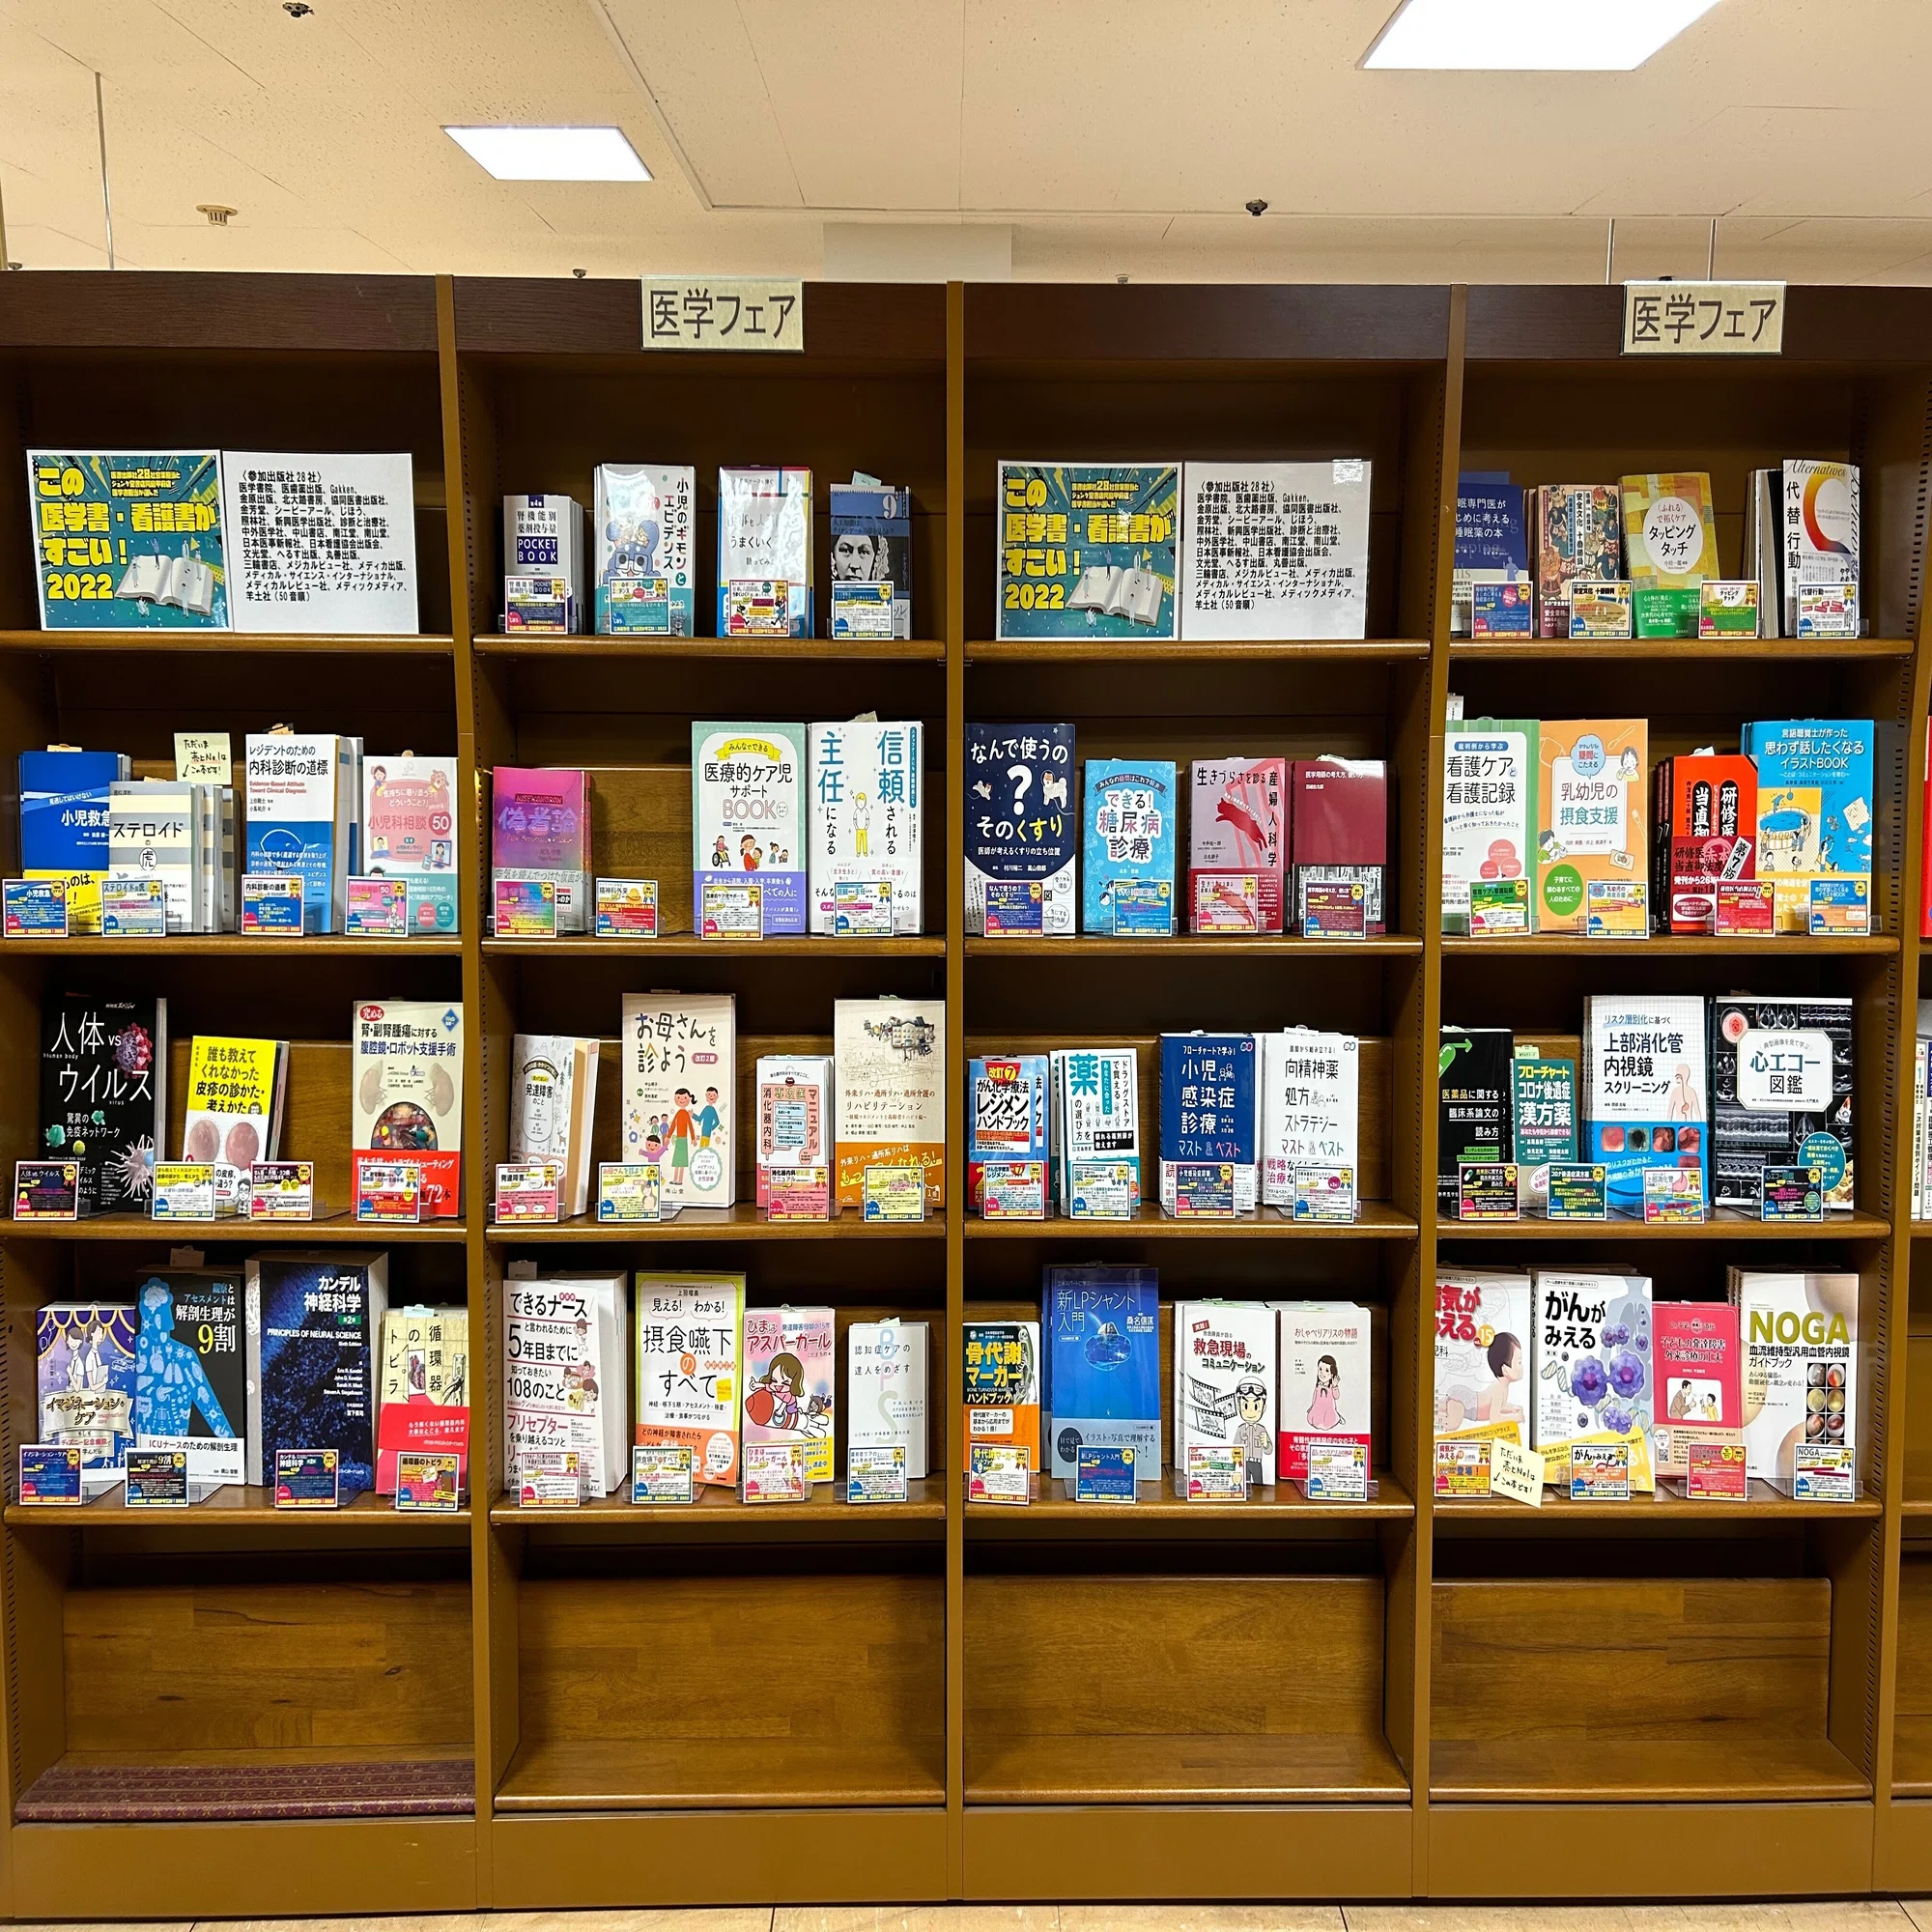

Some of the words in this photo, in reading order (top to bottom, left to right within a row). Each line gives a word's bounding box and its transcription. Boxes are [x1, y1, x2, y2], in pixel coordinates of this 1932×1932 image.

[650, 288, 796, 338] 医学フェア
[1633, 294, 1776, 344] 医学フェア
[39, 468, 84, 496] この
[1007, 478, 1047, 507] この
[40, 499, 218, 532] 医学書・看護書が
[517, 510, 557, 522] 腎機能別
[517, 524, 557, 533] 薬剤投与量
[676, 477, 689, 586] 小児のギモンと
[1006, 509, 1176, 543] 医学書・看護書が
[1649, 524, 1696, 540] タッピング
[1786, 481, 1801, 570] 代替行動
[43, 538, 128, 566] すごい！
[518, 539, 557, 550] POCKET
[1661, 541, 1688, 556] タッチ
[518, 551, 557, 561] BOOK
[1006, 549, 1080, 577] すごい！
[47, 574, 113, 600] 2022
[1005, 582, 1065, 610] 2022
[1782, 728, 1848, 738] 言語聴覚士が作った
[184, 739, 209, 750] ただいま
[249, 745, 315, 756] レジデントのための
[728, 743, 769, 753] みんなでできる
[971, 736, 1068, 764] なんで使うの
[1765, 741, 1864, 755] 思わず話したくなる
[191, 766, 221, 775] この本です!
[249, 759, 328, 776] 内科診断の道標
[705, 762, 793, 783] 医療的ケア児
[1447, 755, 1517, 778] 看護ケアと
[1780, 757, 1848, 769] イラストBOOK
[729, 784, 767, 798] サポート
[818, 730, 844, 856] 主任になる
[876, 730, 905, 856] 信頼される
[1007, 764, 1033, 815] ?
[1447, 782, 1516, 804] 看護記録
[1561, 783, 1618, 801] 乳幼児の
[723, 799, 777, 820] BOOK
[1108, 792, 1152, 809] できる!
[498, 807, 578, 833] 偽者論
[1268, 771, 1278, 867] 産婦人科学
[1560, 807, 1618, 825] 摂食支援
[1720, 786, 1738, 836] 研修医
[113, 822, 184, 838] ステロイド
[369, 815, 427, 831] 小児科相談
[432, 815, 449, 831] 50
[977, 814, 1063, 842] そのくすり
[1099, 810, 1160, 835] 糖尿病
[978, 847, 1061, 856] 医師が考えるくすりの立ち位置
[1110, 836, 1151, 860] 診療
[141, 851, 155, 867] 虎
[636, 1012, 716, 1046] お母さんを
[1605, 1014, 1671, 1025] リスク層別化に基づく
[51, 1011, 105, 1055] 人体
[108, 1035, 121, 1046] VS
[361, 1023, 438, 1037] 腎・副腎腫瘍に対する
[360, 1040, 456, 1057] 腹腔鏡・ロボット支援手術
[1183, 1045, 1236, 1056] フローチャートで学ぶ!
[1604, 1033, 1684, 1053] 上部消化管
[207, 1046, 256, 1063] 誰も教えて
[638, 1043, 686, 1073] 診よう
[1749, 1051, 1820, 1072] 心エコー
[202, 1064, 259, 1081] くれなかった
[988, 1066, 1004, 1077] 改訂
[1007, 1065, 1014, 1080] 7
[1068, 1054, 1098, 1096] 薬
[1181, 1059, 1216, 1082] 小児
[1285, 1059, 1339, 1080] 向精神薬
[1518, 1065, 1570, 1079] フローチャート
[1604, 1056, 1654, 1077] 内視鏡
[59, 1064, 152, 1103] ウイルス
[526, 1084, 554, 1097] 発達障害
[977, 1081, 1029, 1094] がん化学療法
[1519, 1081, 1571, 1100] コロナ後遺症
[1604, 1080, 1670, 1094] スクリーニング
[1770, 1075, 1803, 1094] 図鑑
[845, 1090, 935, 1098] 外来リハ・通所リハ・通所介護の
[1181, 1086, 1236, 1109] 感染症
[1286, 1087, 1309, 1106] 処方
[1442, 1090, 1499, 1099] 医薬品に関する
[207, 1099, 246, 1114] 考えかた
[846, 1101, 923, 1111] リハビリテーション
[977, 1094, 1029, 1116] レジメン
[1449, 1108, 1499, 1118] 臨床系論文の
[1519, 1102, 1572, 1126] 漢方薬
[67, 1112, 89, 1123] 驚異の
[763, 1088, 772, 1150] 消化器内科
[809, 1089, 818, 1151] マニュアル
[977, 1116, 1029, 1130] ハンドブック
[1181, 1112, 1216, 1135] 診療
[1285, 1115, 1338, 1133] ストラテジー
[67, 1127, 121, 1137] 免疫ネットワーク
[1475, 1126, 1499, 1137] 読み方
[213, 1283, 234, 1293] 観察と
[319, 1276, 360, 1291] カンデル
[185, 1294, 235, 1305] アセスメントは
[304, 1293, 361, 1313] 神経科学
[510, 1293, 588, 1318] できるナース
[652, 1298, 682, 1312] 見える!
[694, 1300, 724, 1313] わかる!
[1057, 1290, 1136, 1311] 新LPシャント
[1545, 1291, 1605, 1323] がんが
[175, 1305, 235, 1322] 解剖生理が
[1059, 1312, 1085, 1332] 入門
[268, 1328, 300, 1338] PRINCIPLES
[301, 1329, 310, 1338] OF
[310, 1329, 335, 1339] NEURAL
[525, 1322, 573, 1335] と言われるために
[1294, 1328, 1358, 1339] おしゃべりアリスの物語
[1545, 1325, 1595, 1349] みえる
[1749, 1310, 1850, 1345] NOGA
[197, 1324, 236, 1354] 9割
[508, 1324, 579, 1361] 5年目までに
[643, 1325, 733, 1355] 摂食嚥下
[747, 1333, 832, 1353] アスパーガール
[1193, 1338, 1252, 1359] 救急現場の
[1661, 1337, 1725, 1350] 子どもの発達障害
[429, 1325, 442, 1392] 循環器
[855, 1345, 911, 1354] 認知症ケアの
[966, 1341, 1022, 1365] 骨代謝
[1749, 1346, 1850, 1358] 血流維持型汎用血管内視鏡
[389, 1328, 399, 1395] トビラ
[511, 1365, 552, 1377] 知っておきたい
[855, 1364, 910, 1376] 達人をめざす
[1202, 1358, 1265, 1374] コミュニケーション
[1748, 1357, 1793, 1368] ガイドブック
[659, 1370, 717, 1399] すべて
[966, 1367, 1022, 1387] マーカー
[507, 1378, 565, 1402] 108のこと
[966, 1392, 1012, 1404] ハンドブック
[507, 1414, 568, 1434] プリセプター
[149, 1439, 238, 1452] ICUナースのための解剖生理
[510, 1433, 566, 1447] を乗り越えるコツと
[1085, 1434, 1155, 1443] イラスト・写真で理解する
[1499, 1446, 1523, 1463] ただいま
